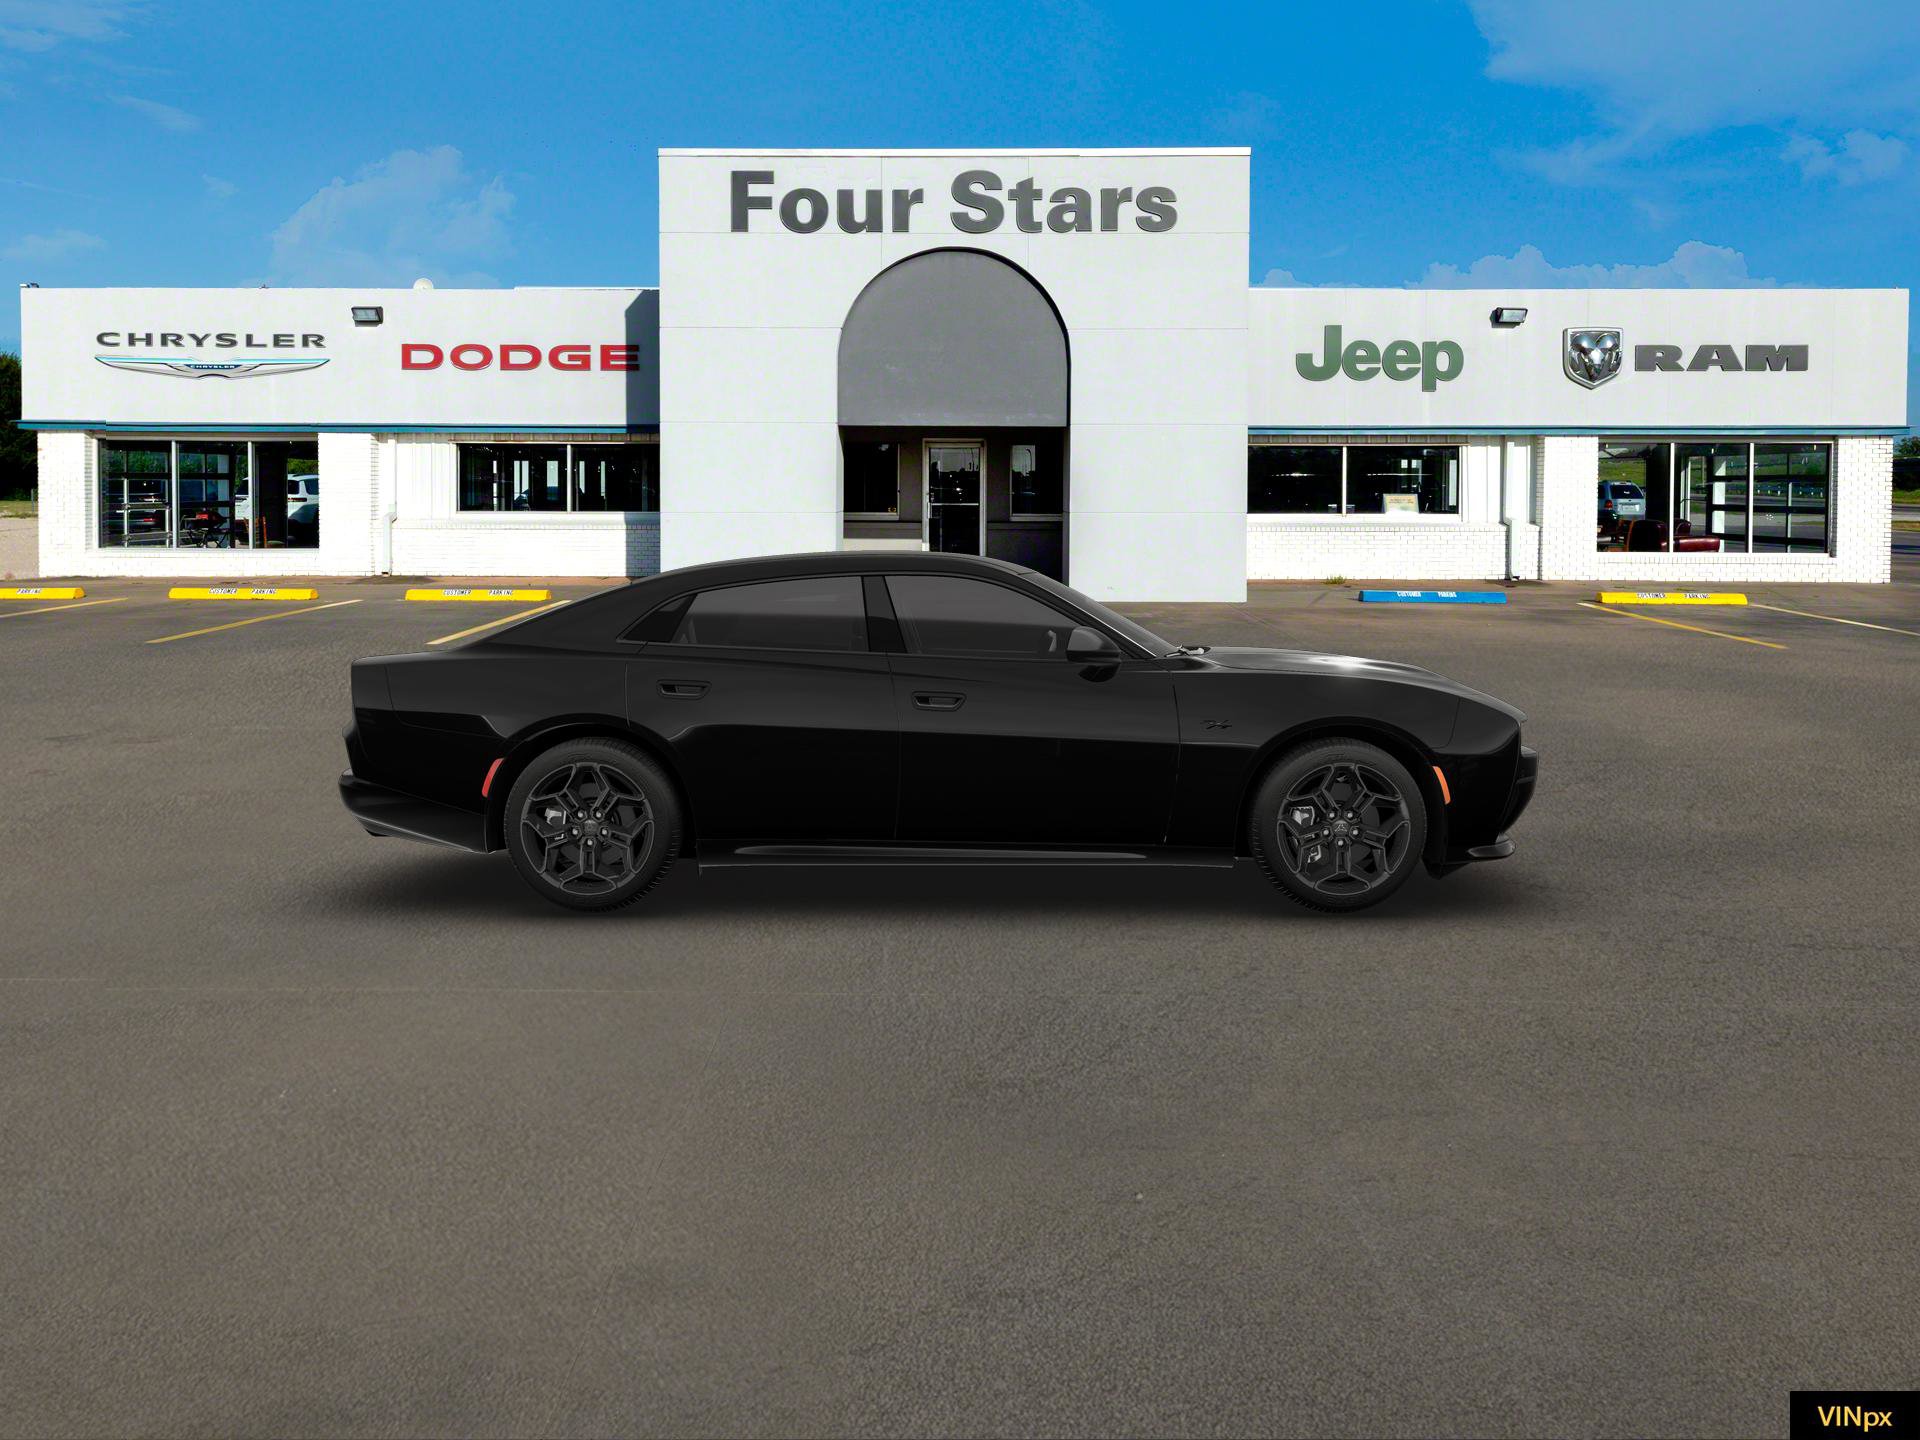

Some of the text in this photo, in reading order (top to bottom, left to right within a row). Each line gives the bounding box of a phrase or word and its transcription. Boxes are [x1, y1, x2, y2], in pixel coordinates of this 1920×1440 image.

[731, 169, 1178, 234] Four Stars
[96, 332, 326, 348] CHRYSLER
[401, 343, 640, 371] DODGE
[1295, 325, 1464, 392] Jeep
[1634, 344, 1809, 371] RAM
